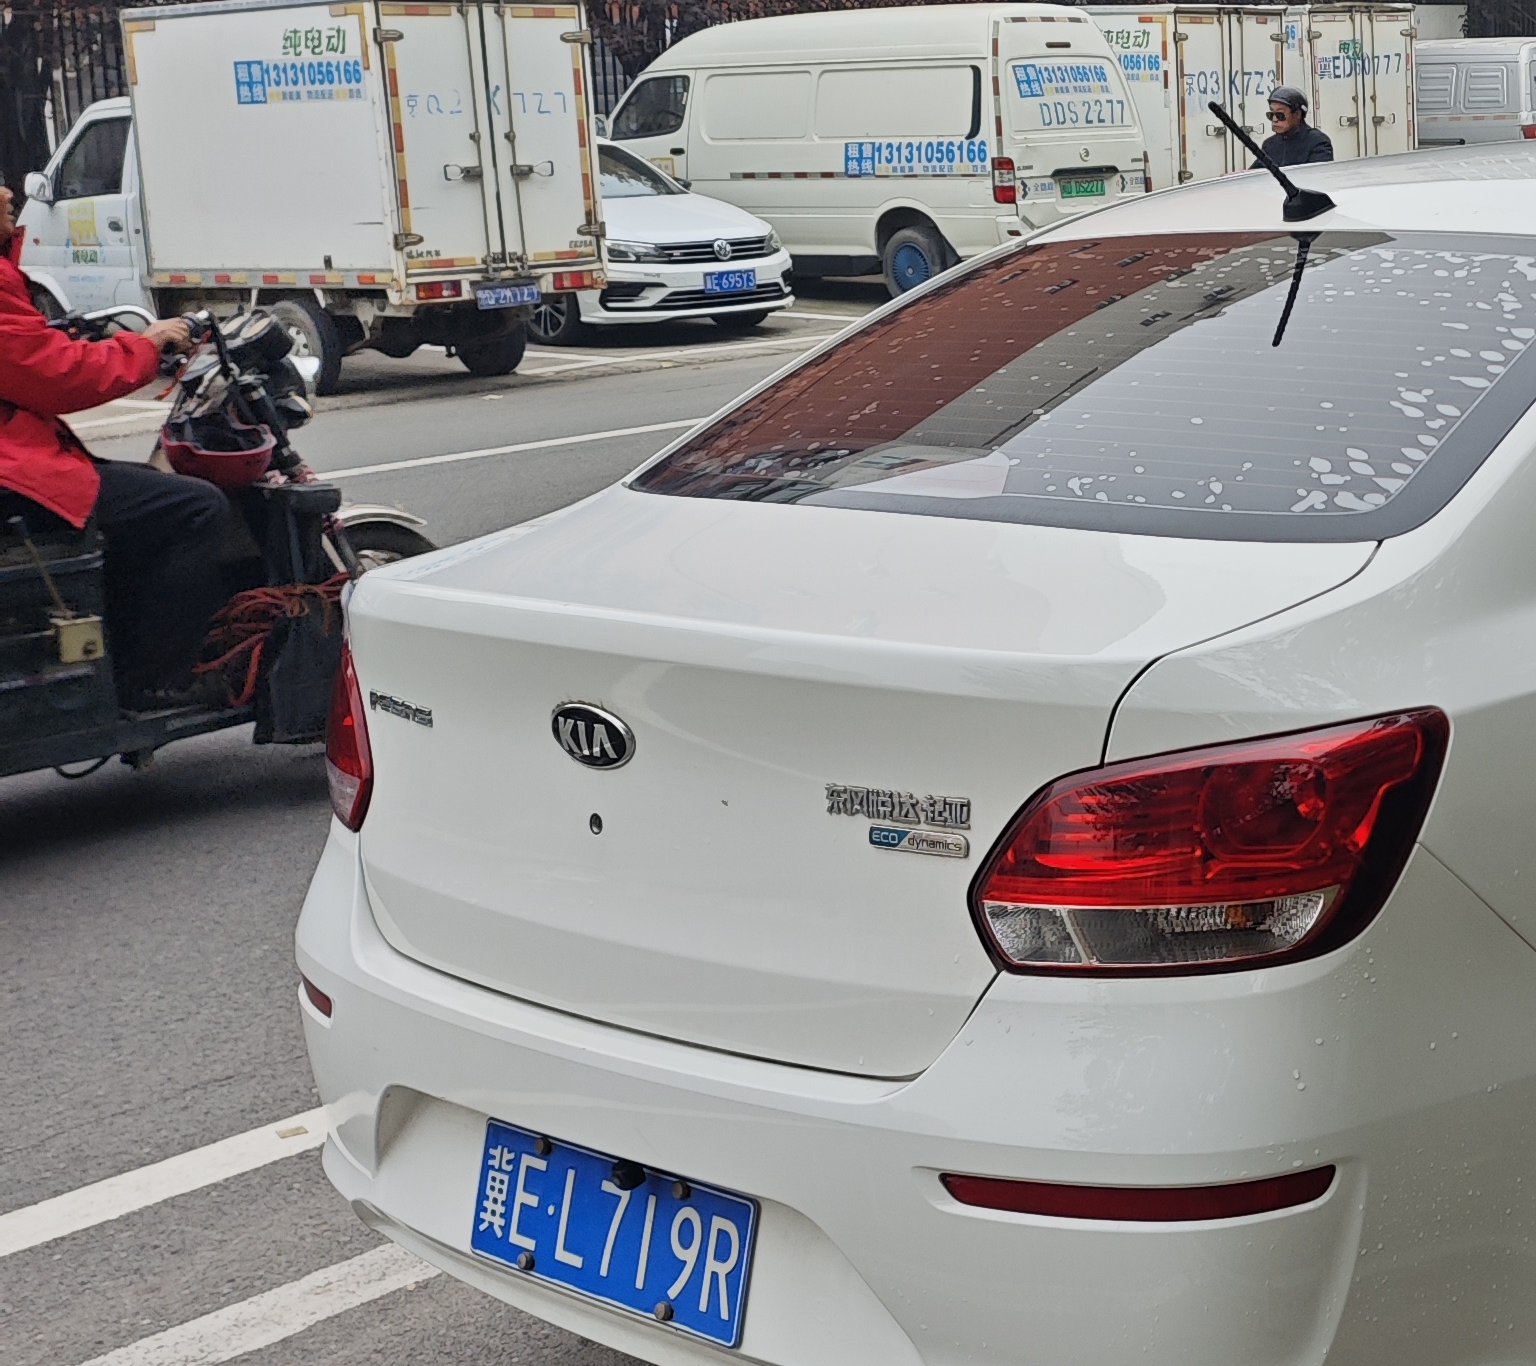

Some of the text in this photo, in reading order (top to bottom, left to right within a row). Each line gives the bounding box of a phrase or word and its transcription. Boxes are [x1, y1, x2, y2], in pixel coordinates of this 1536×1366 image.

[281, 25, 346, 56] 纯电动
[264, 59, 362, 87] 13131056166
[1038, 64, 1108, 84] 13131056166
[876, 140, 988, 165] 13131056166
[557, 715, 618, 759] KIA
[871, 830, 962, 852] ECO dynamics
